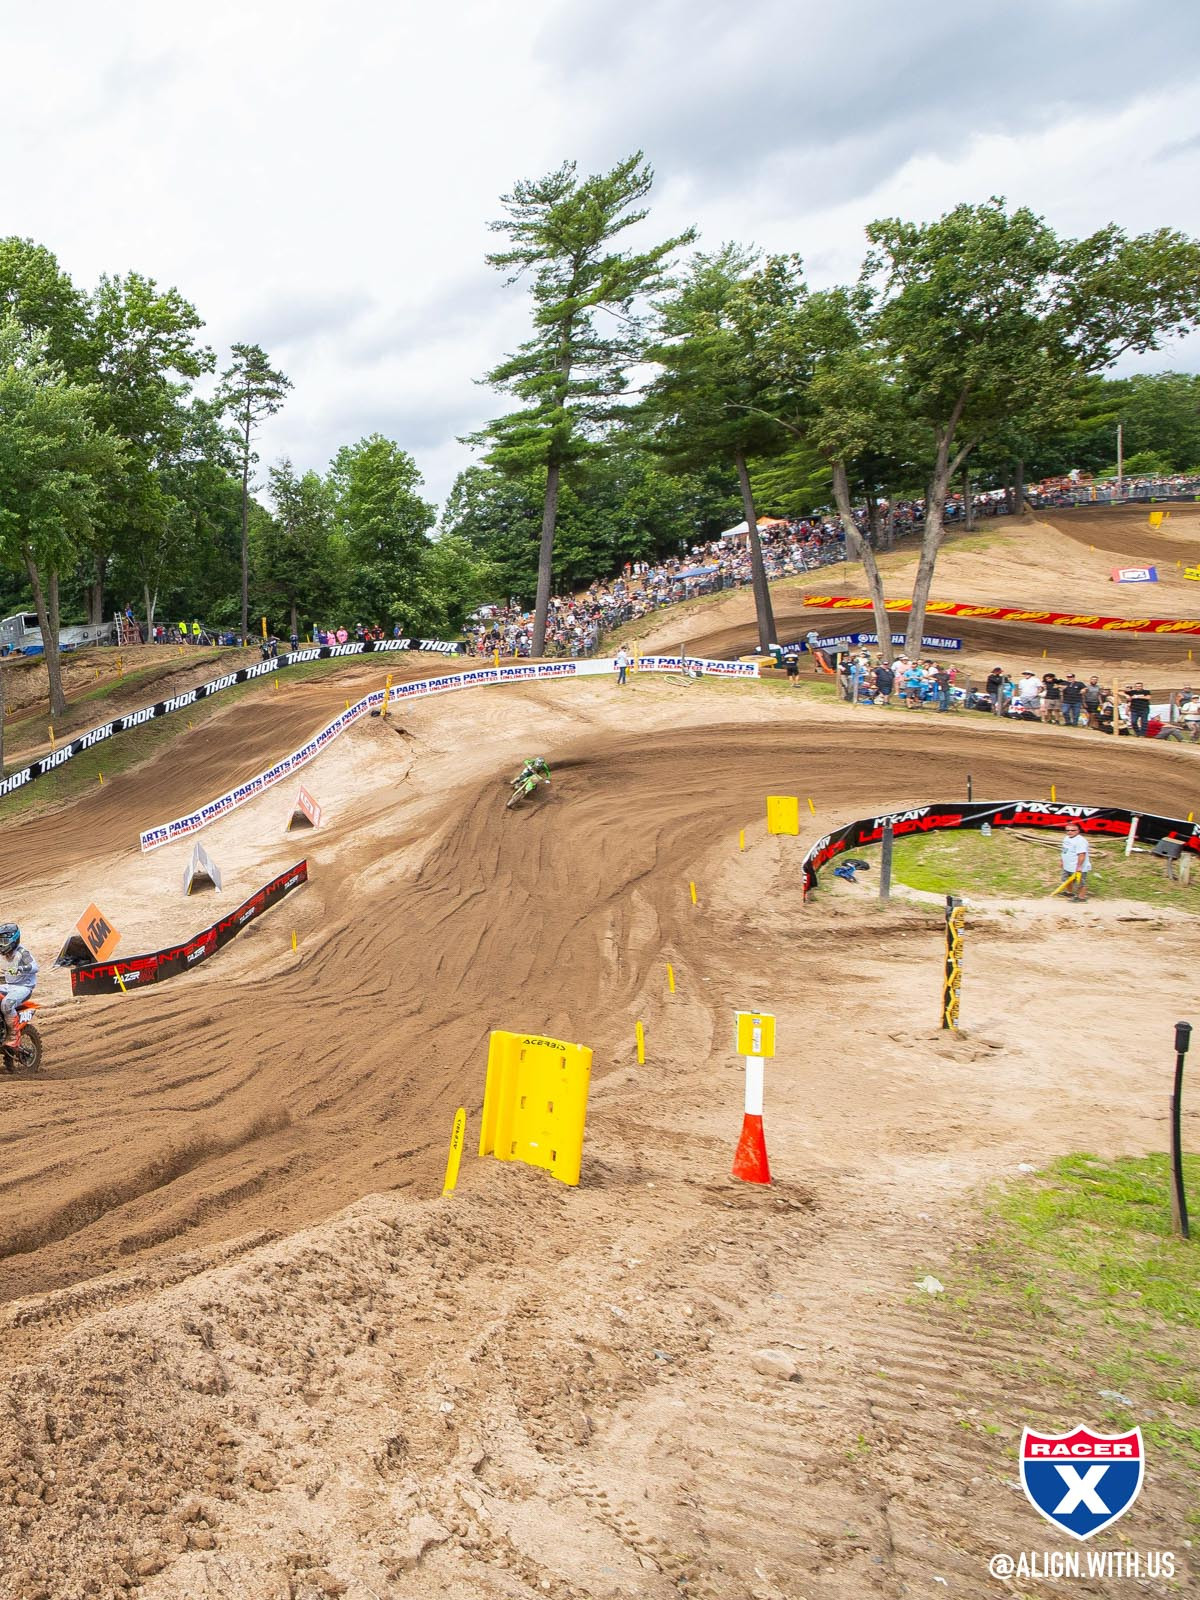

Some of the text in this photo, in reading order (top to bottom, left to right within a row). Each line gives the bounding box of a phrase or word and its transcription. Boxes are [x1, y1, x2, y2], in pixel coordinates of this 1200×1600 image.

[329, 642, 364, 657] THOR
[373, 639, 411, 651] THOR
[418, 639, 458, 652] THOR
[922, 638, 957, 648] YAMAHA
[286, 648, 321, 665] THOR
[707, 662, 754, 670] PARTS
[245, 658, 279, 679] THOR
[463, 670, 497, 681] PARTS
[500, 667, 535, 676] PARTS
[538, 664, 576, 673] PARTS
[538, 669, 576, 678] UNLIMITED
[204, 674, 238, 695] THOR
[396, 682, 427, 694] PARTS
[428, 675, 461, 687] PARTS
[163, 691, 197, 713] THOR
[368, 688, 395, 703] PARS
[121, 707, 155, 729] THOR
[341, 700, 367, 722] PARTS
[80, 723, 113, 749] THOR
[316, 720, 341, 744] PARTS
[39, 745, 73, 773] THOR
[291, 741, 317, 764] PARTS
[263, 760, 290, 781] PARTS
[234, 778, 262, 799] PARTS
[202, 796, 232, 817] PARTS
[1015, 802, 1100, 816] MX-ATV
[169, 814, 201, 833] PARTS
[993, 812, 1132, 835] LEGENDS
[87, 917, 112, 954] KTM
